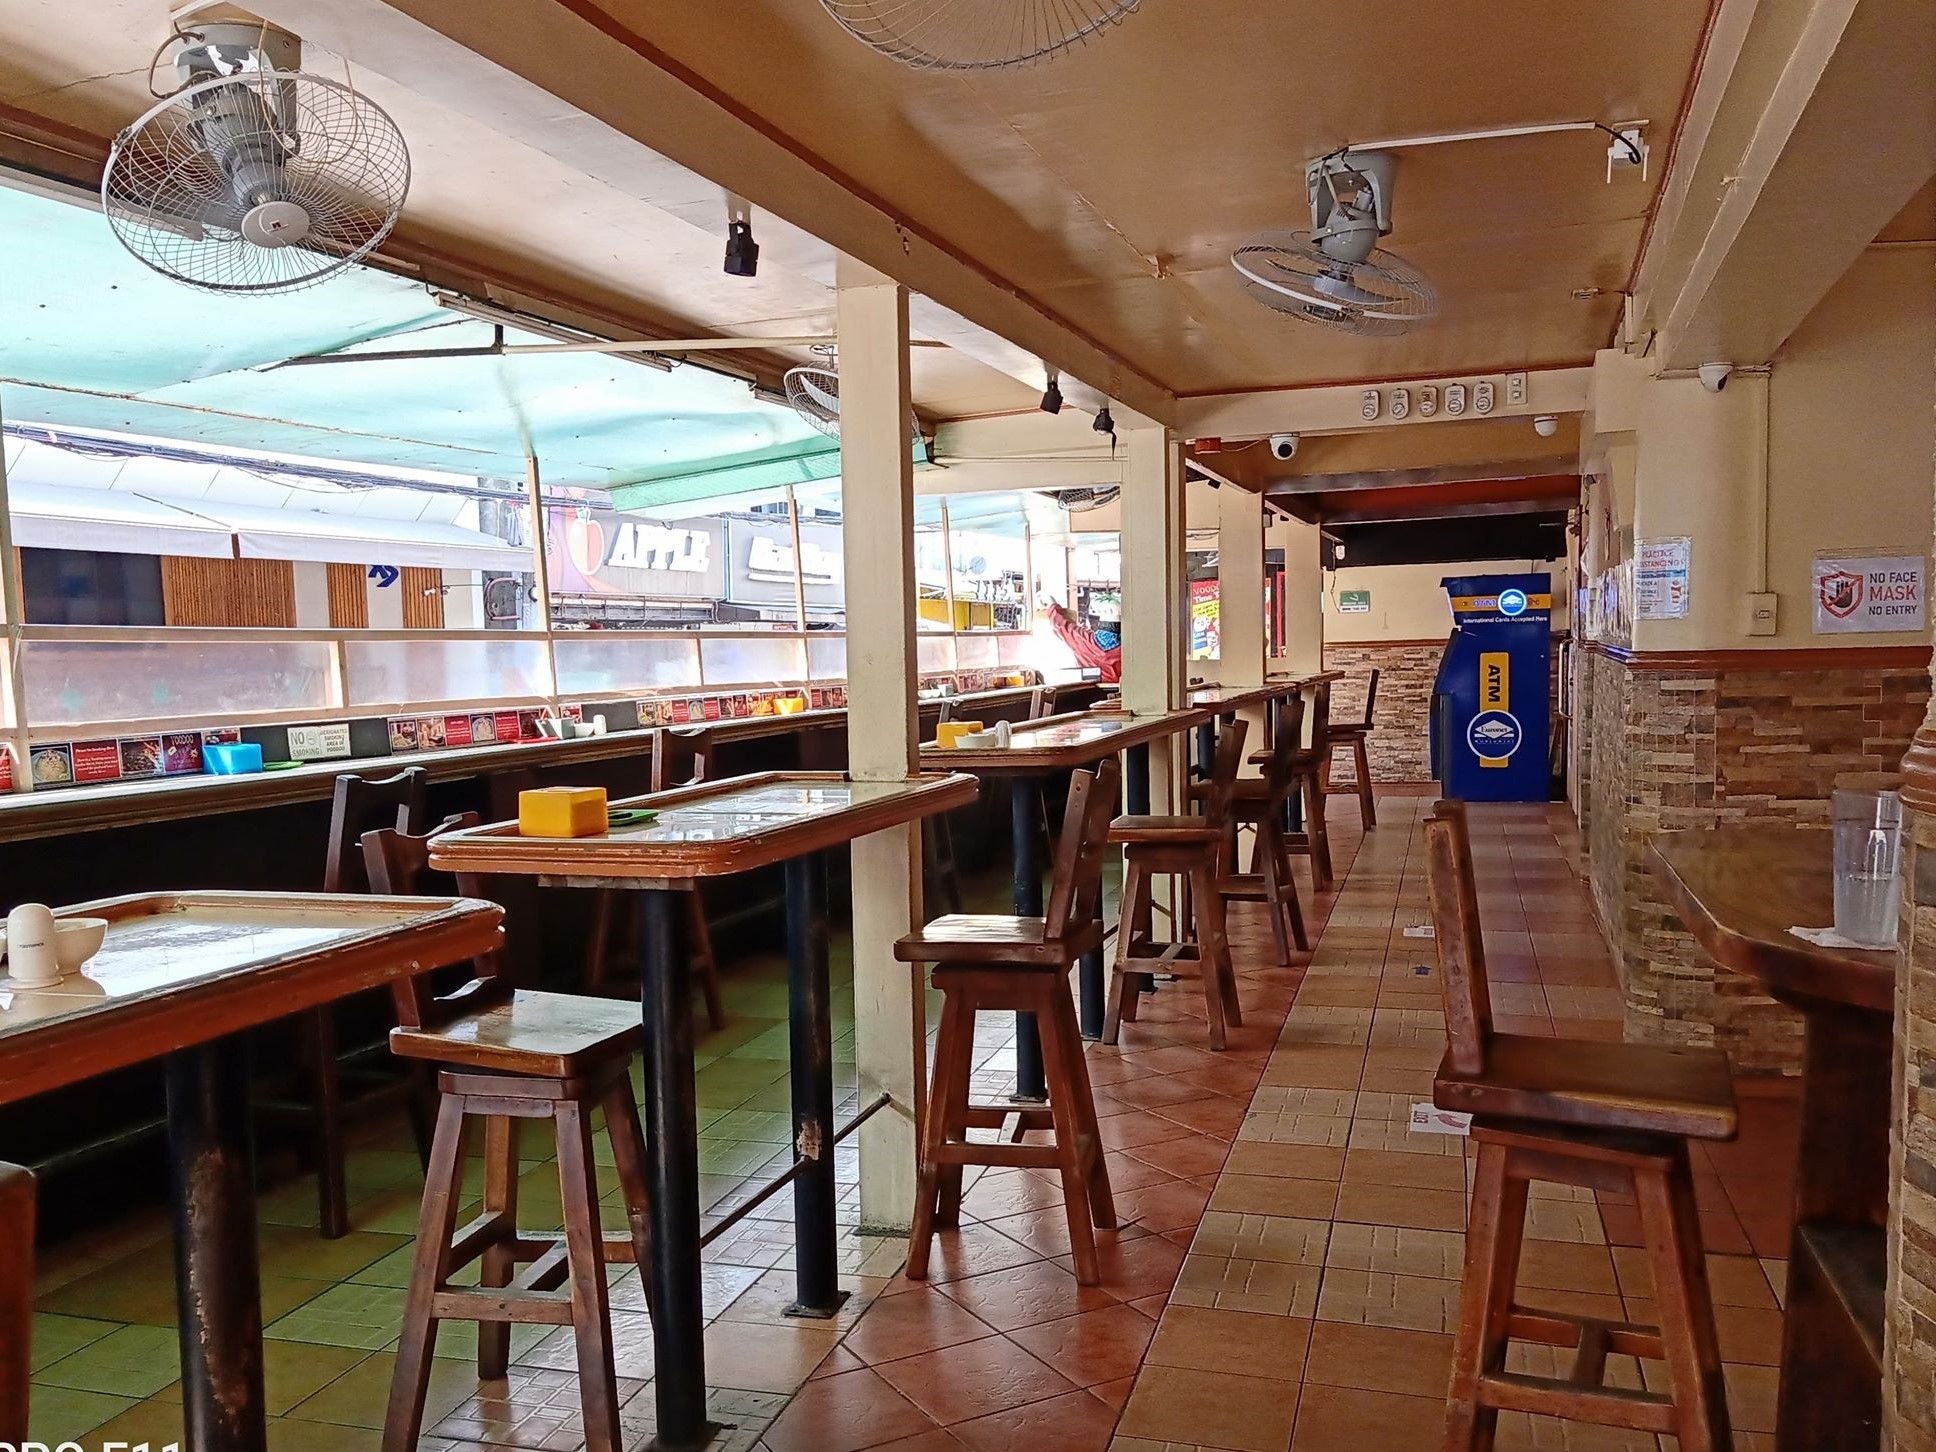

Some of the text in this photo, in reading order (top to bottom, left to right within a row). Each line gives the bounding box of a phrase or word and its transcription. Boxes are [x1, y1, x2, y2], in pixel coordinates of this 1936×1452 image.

[606, 522, 711, 573] APPLE
[1869, 572, 1918, 583] NO FACE
[1870, 585, 1917, 601] MASK
[1868, 605, 1918, 615] NO ENTRY
[1511, 615, 1535, 623] Accepted
[1488, 664, 1501, 702] ATM
[290, 731, 305, 746] NO
[291, 746, 320, 758] SMOKING
